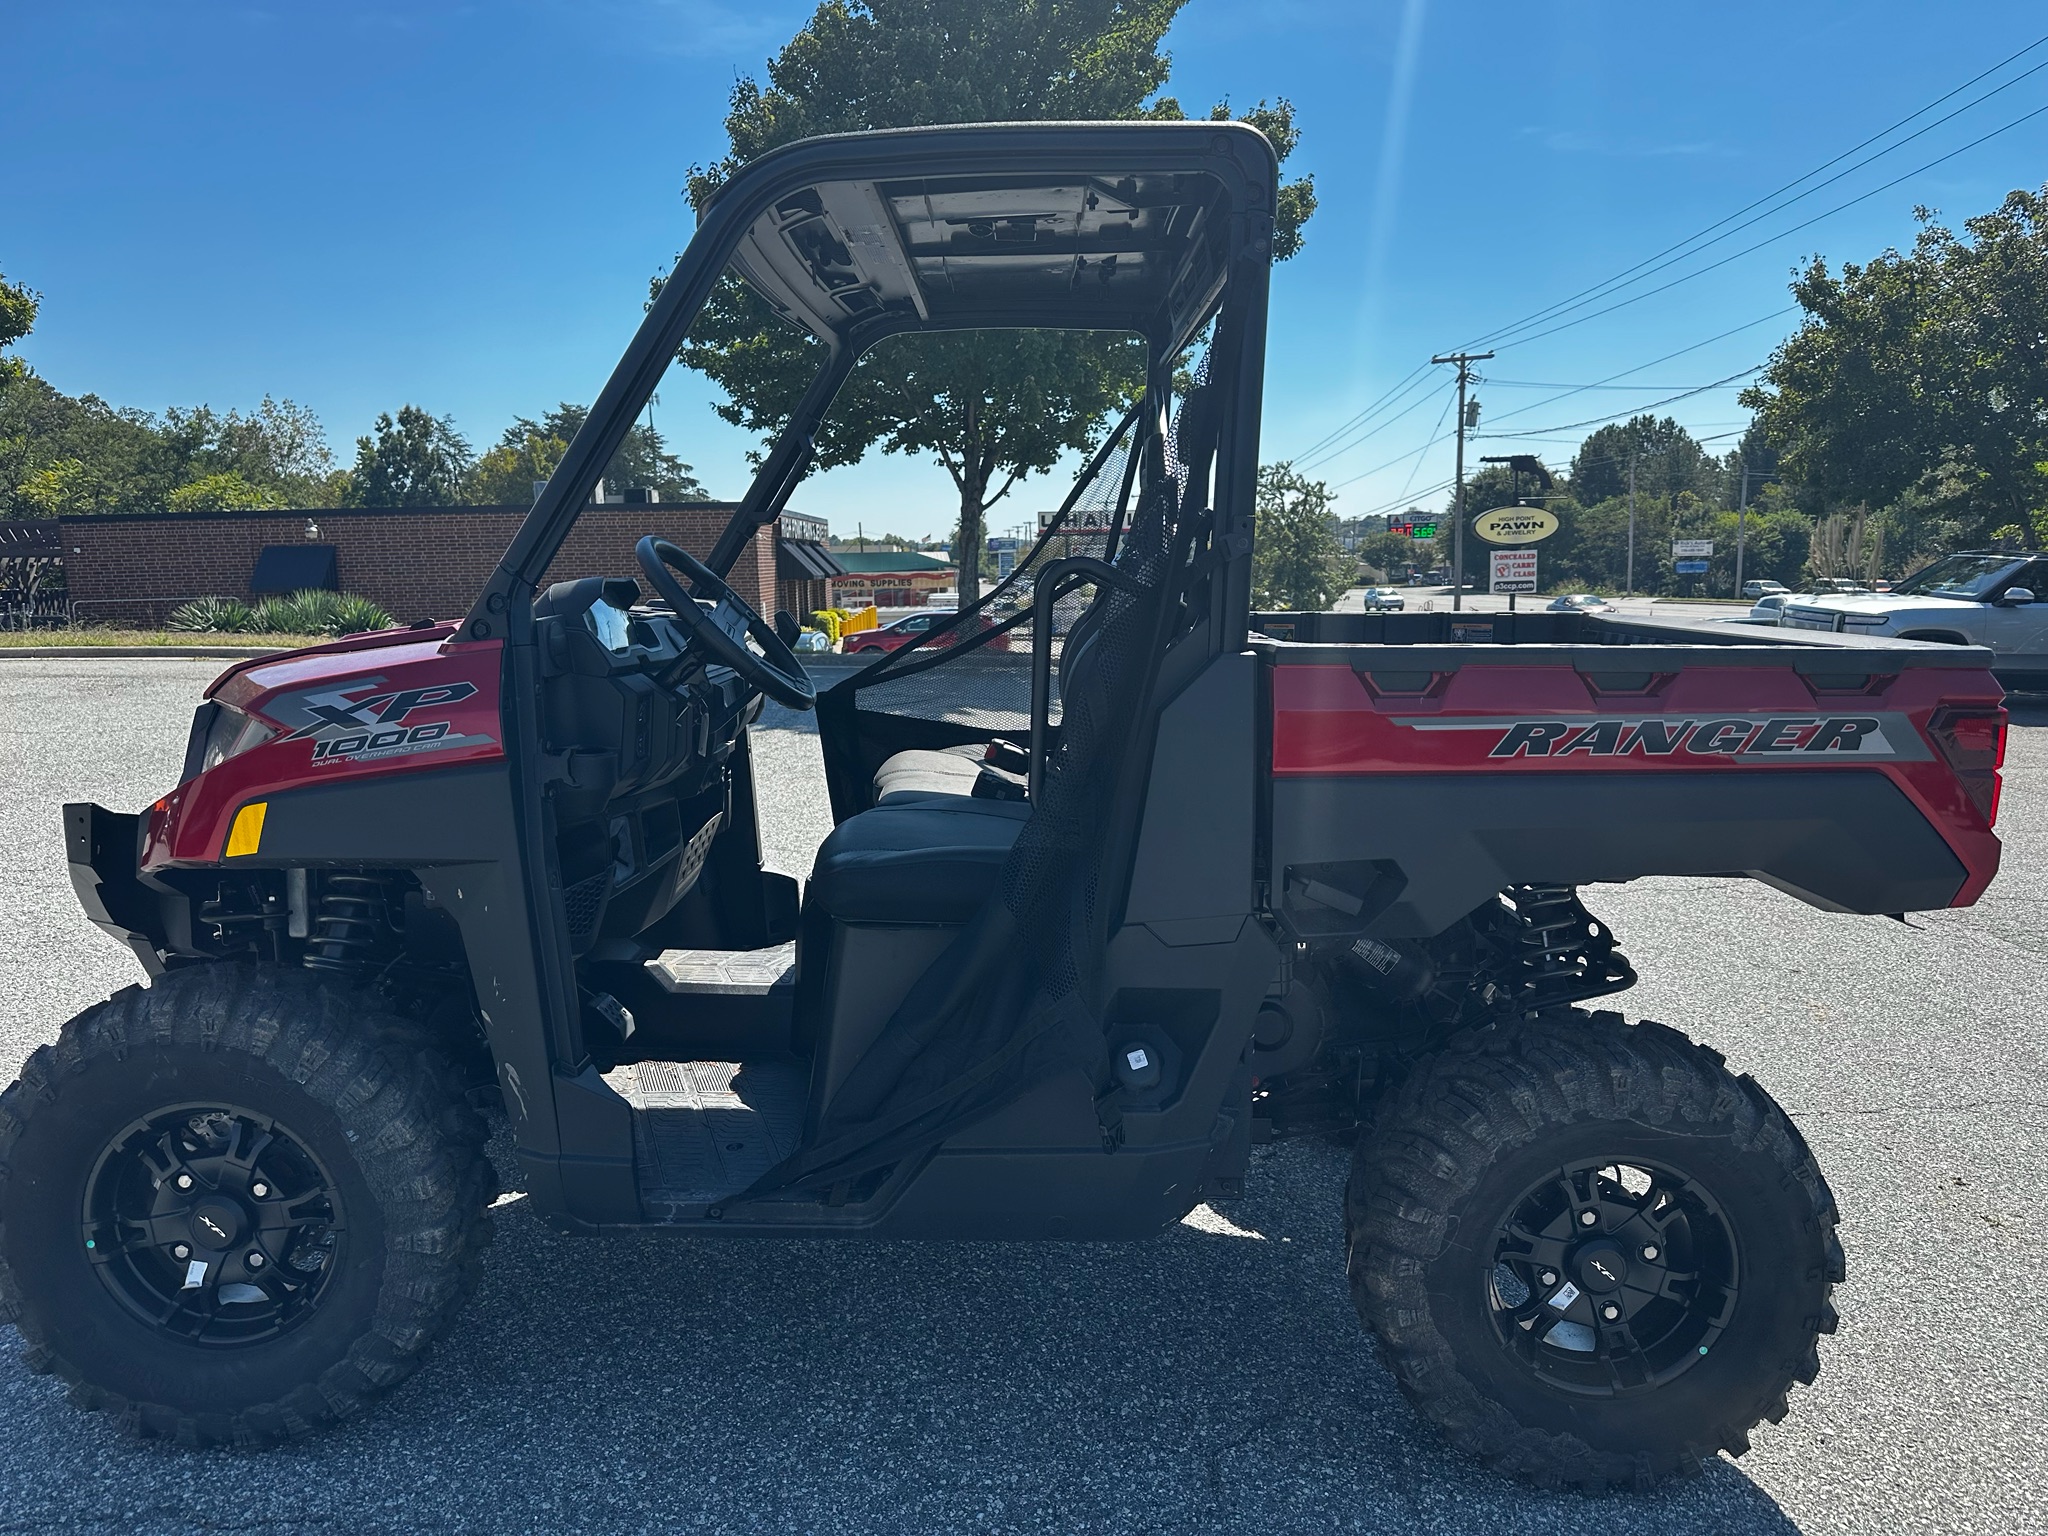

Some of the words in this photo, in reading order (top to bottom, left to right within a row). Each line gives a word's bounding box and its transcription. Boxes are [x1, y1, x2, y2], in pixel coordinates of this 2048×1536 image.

[1490, 521, 1544, 531] PAWN
[1494, 553, 1536, 561] CONCEALED
[870, 579, 912, 587] SUPPLIES
[1494, 583, 1534, 591] p3ccp.com
[272, 681, 479, 744] XP
[311, 720, 450, 760] 1000
[1488, 716, 1880, 757] RANGER
[312, 758, 343, 767] DUAL
[345, 747, 411, 761] OVERHEAD
[413, 742, 441, 751] CAM
[199, 1216, 226, 1238] XP
[1590, 1260, 1616, 1281] XP
